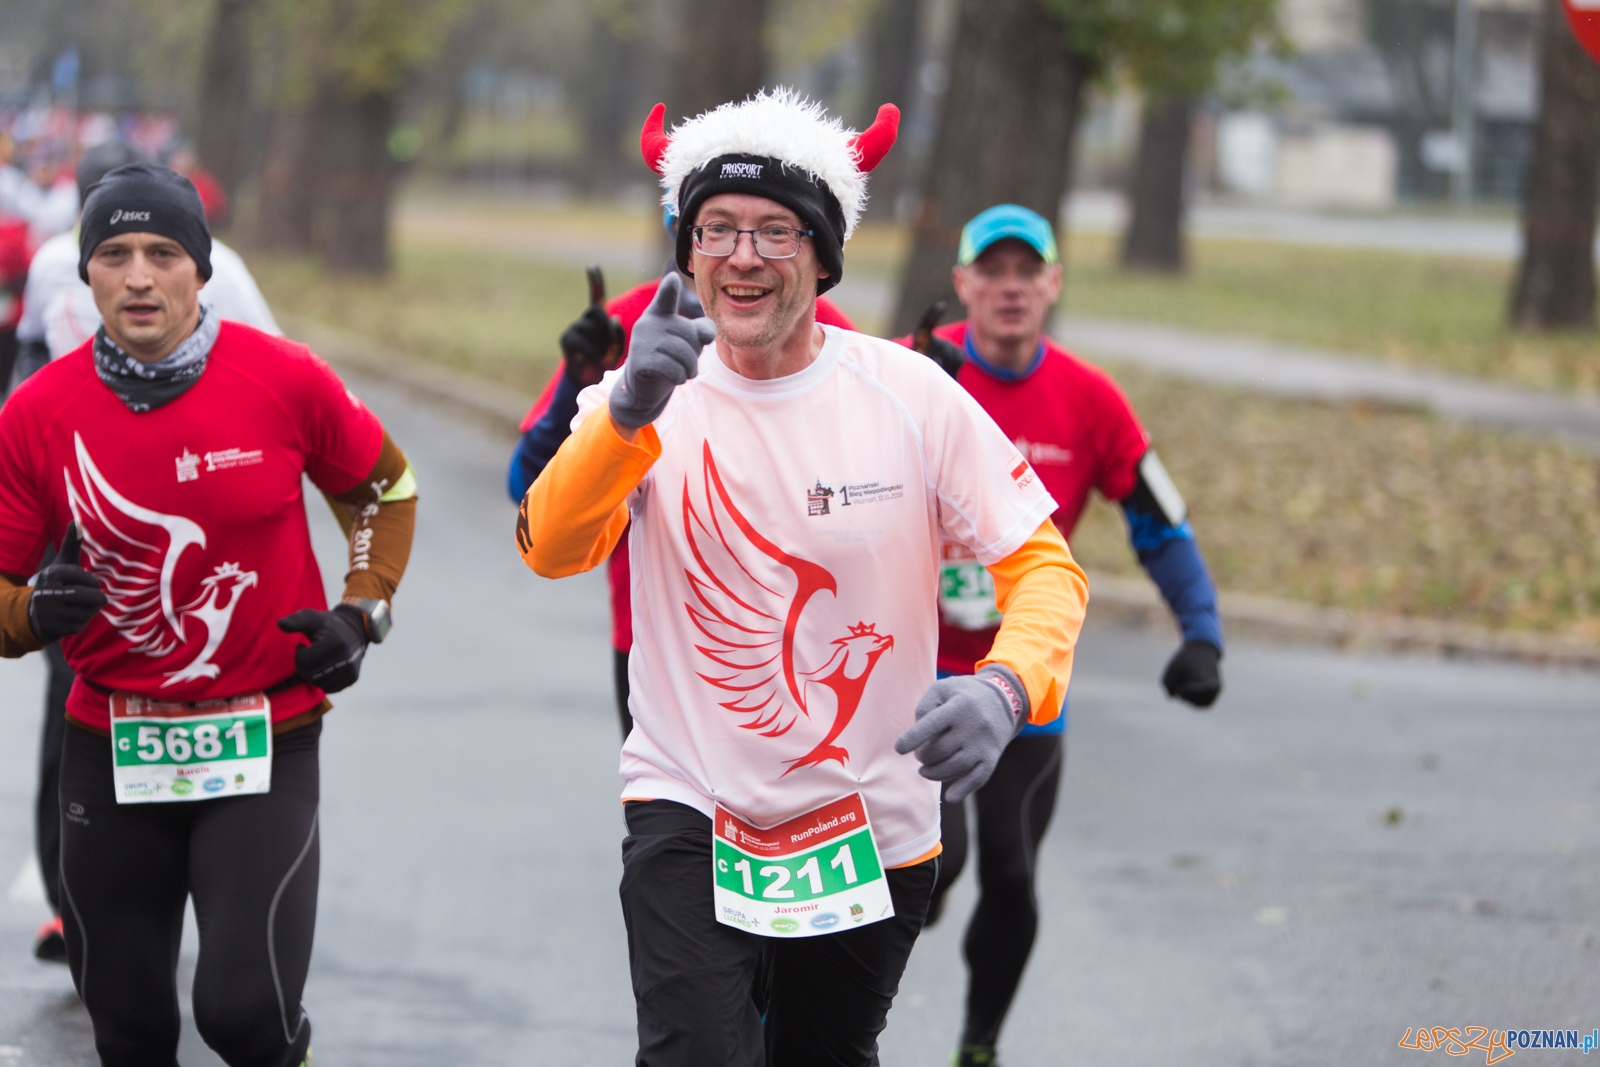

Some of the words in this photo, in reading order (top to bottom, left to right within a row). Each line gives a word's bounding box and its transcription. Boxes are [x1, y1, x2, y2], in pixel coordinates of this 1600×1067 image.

[839, 485, 851, 506] 1
[137, 720, 249, 762] 5681
[176, 766, 210, 777] Marcin
[790, 811, 857, 844] RunPoland.org
[734, 843, 859, 899] 1211
[723, 906, 746, 919] GRUPA
[774, 903, 819, 914] Jaromir
[723, 914, 751, 928] LUXMED
